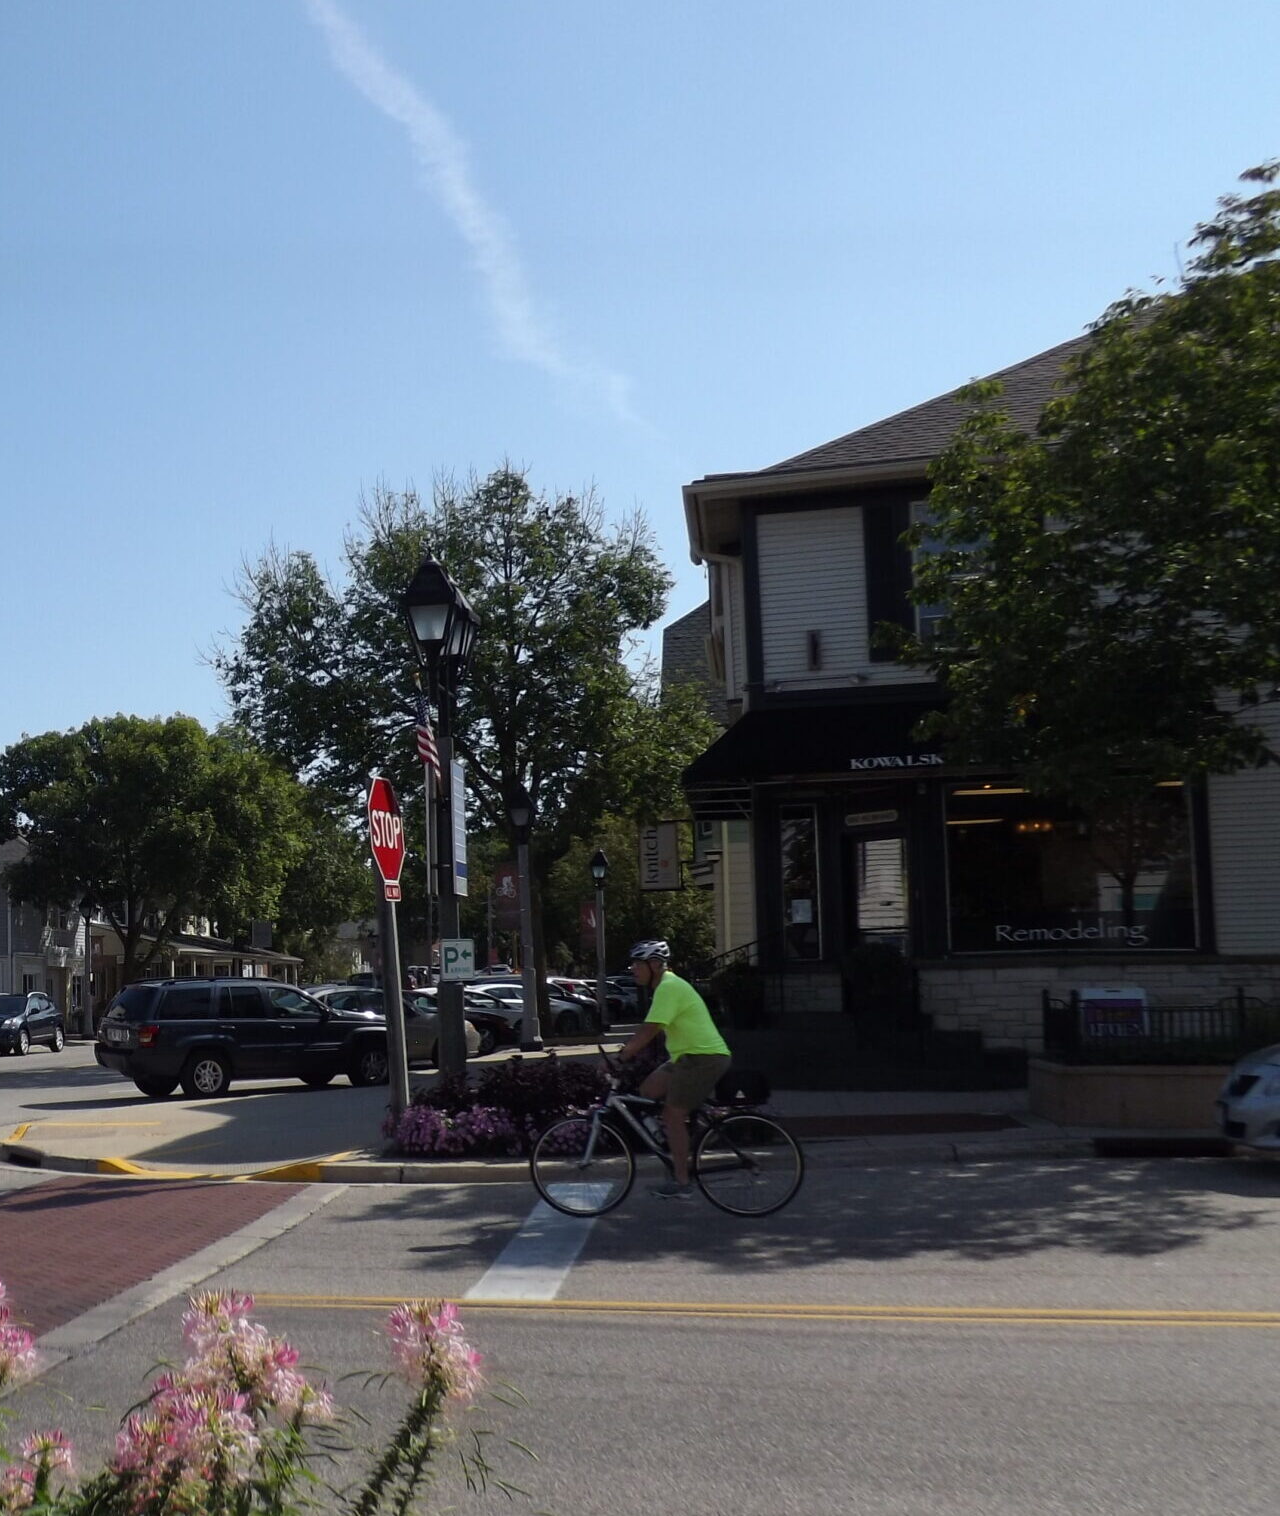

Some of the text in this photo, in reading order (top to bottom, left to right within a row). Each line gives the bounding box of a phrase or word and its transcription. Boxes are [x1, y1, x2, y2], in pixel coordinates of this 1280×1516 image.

[371, 809, 401, 850] STOP
[643, 829, 659, 884] knitch
[994, 917, 1150, 947] Remodeling
